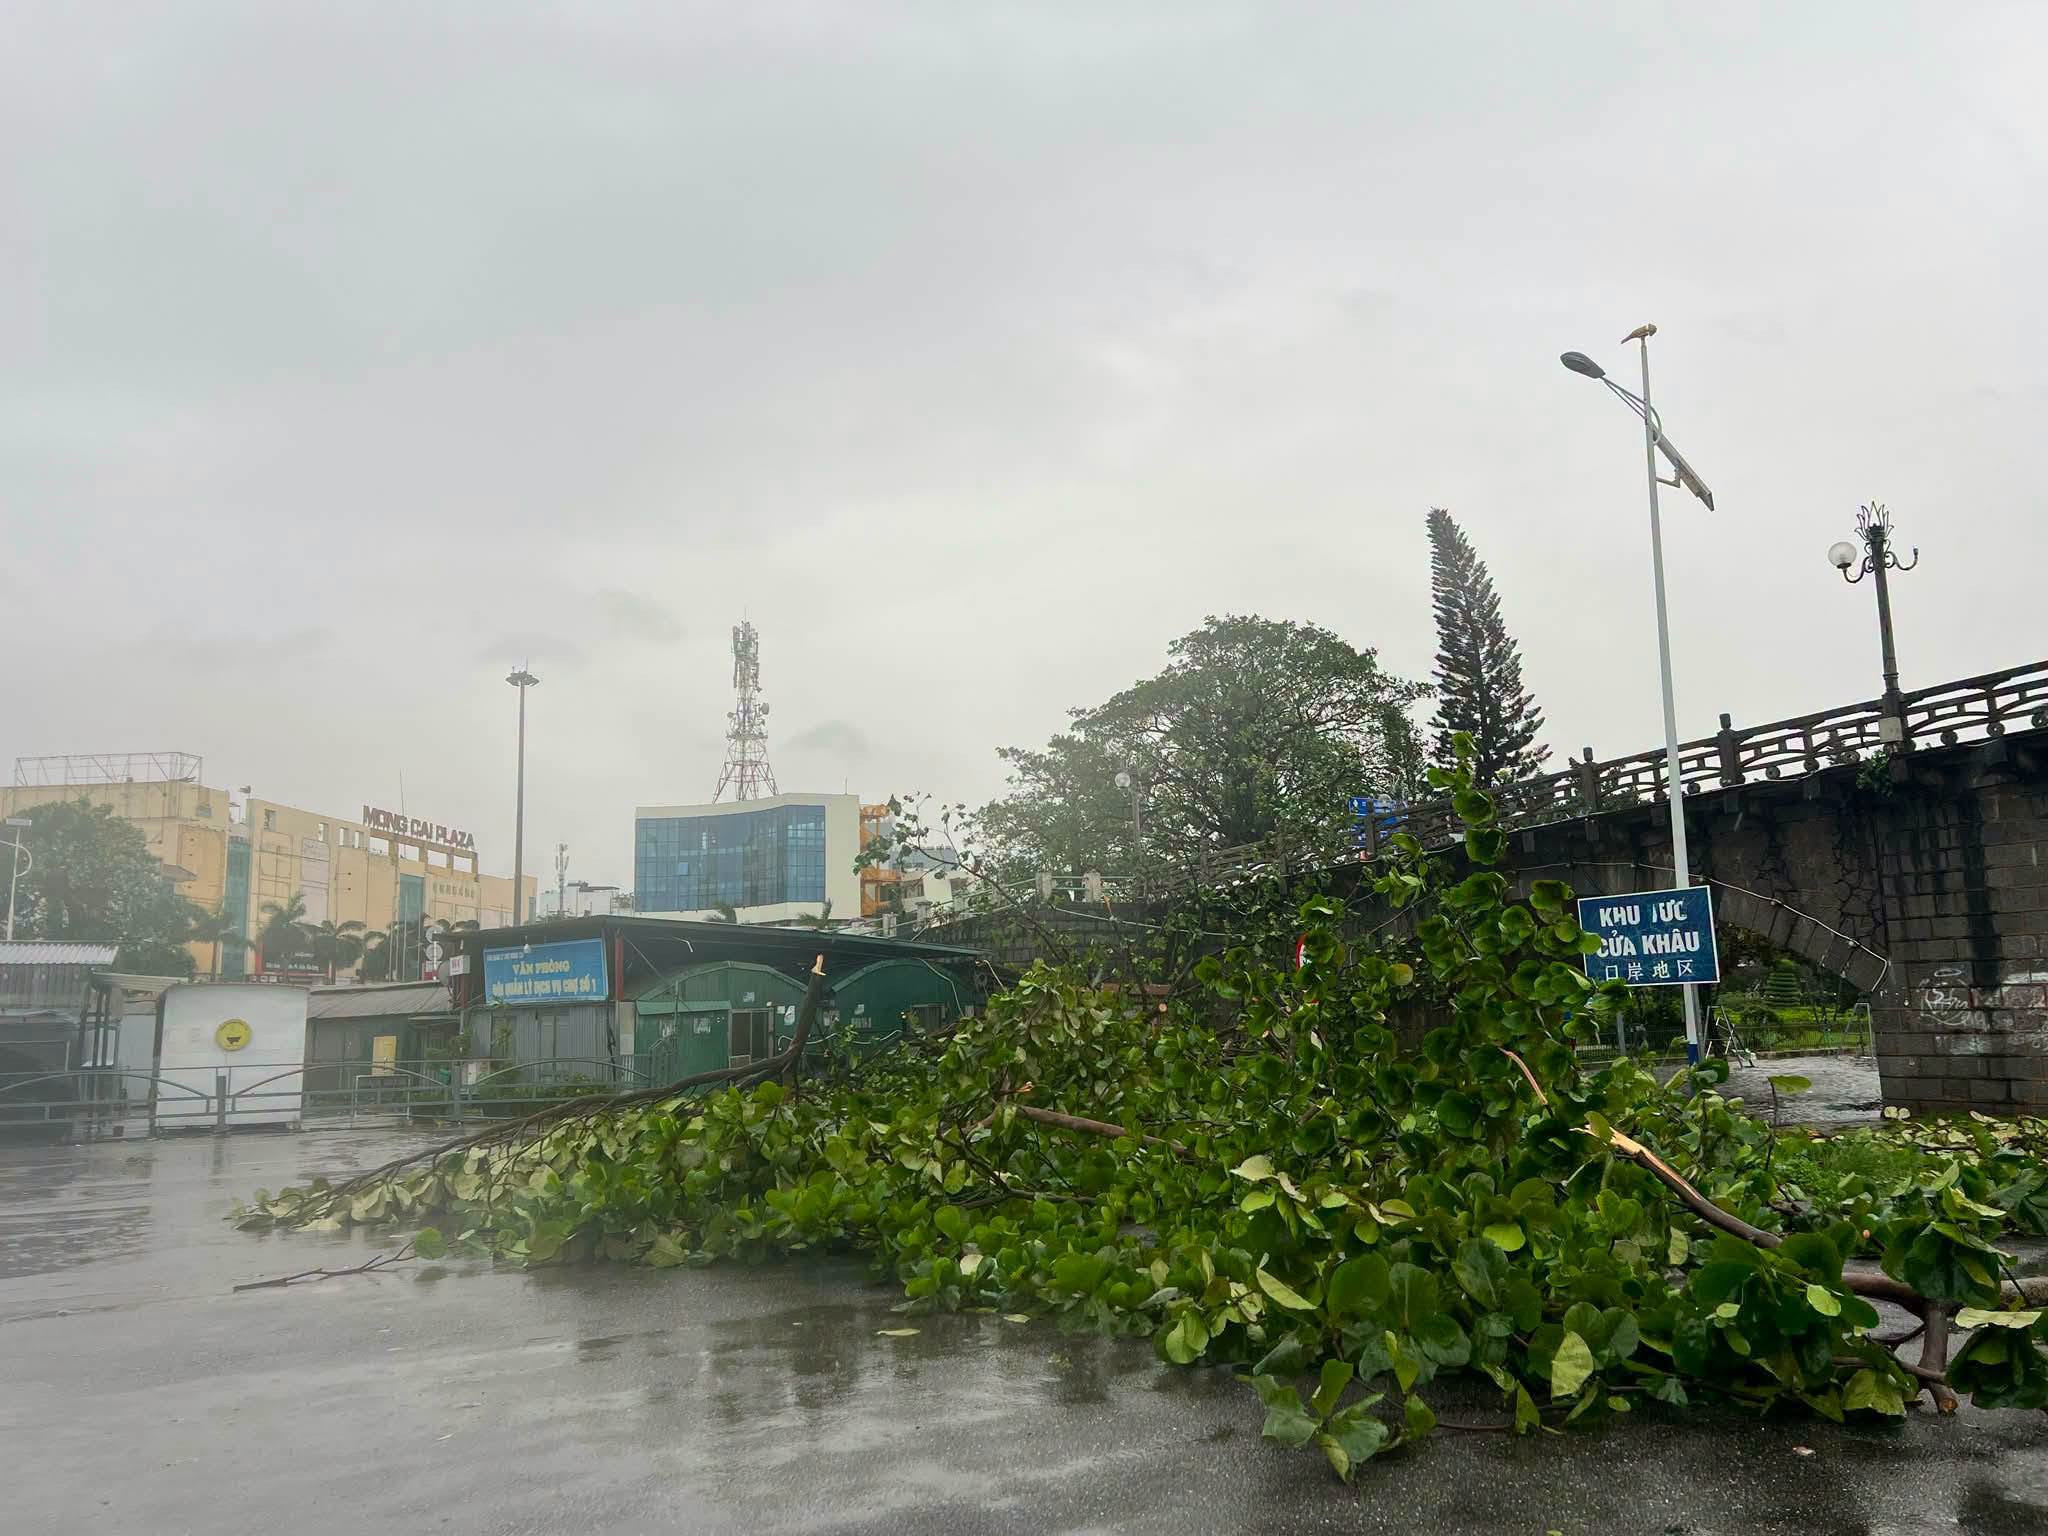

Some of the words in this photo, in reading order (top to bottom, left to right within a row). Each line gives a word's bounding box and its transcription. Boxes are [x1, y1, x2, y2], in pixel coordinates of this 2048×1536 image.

[436, 825, 475, 849] PLAZA
[1600, 905, 1640, 927] KHU
[1597, 929, 1637, 958] CỬA
[1605, 959, 1693, 981] 口岸地区
